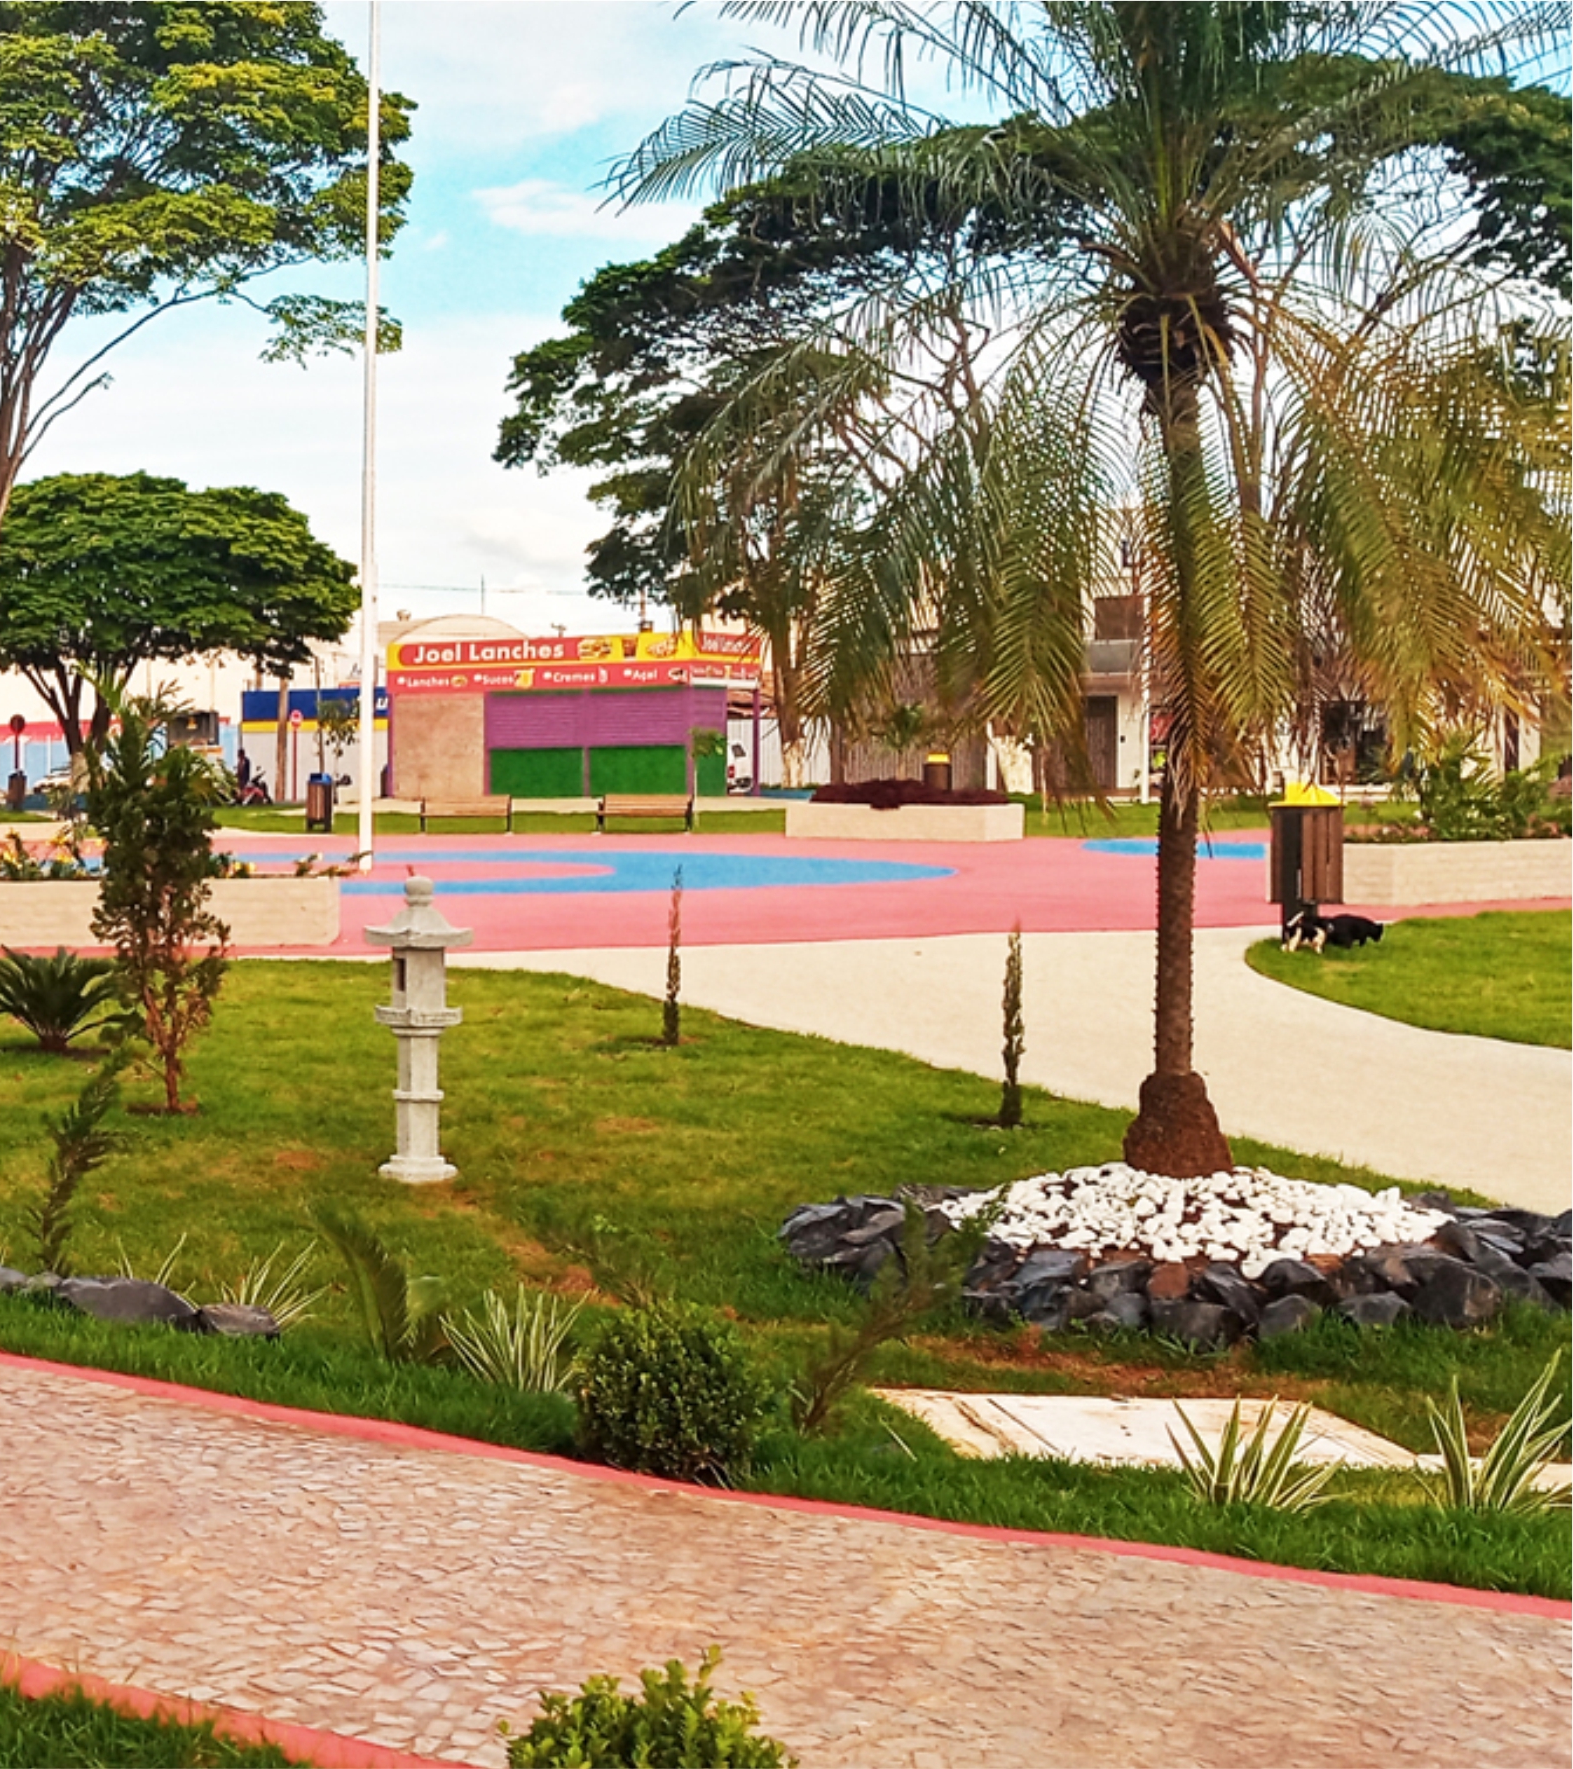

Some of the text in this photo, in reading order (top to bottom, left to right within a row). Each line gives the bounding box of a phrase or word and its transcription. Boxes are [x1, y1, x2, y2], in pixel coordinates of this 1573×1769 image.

[413, 638, 565, 663] Joel Lanches
[407, 676, 449, 687] Lanches
[553, 671, 594, 683] Cremes
